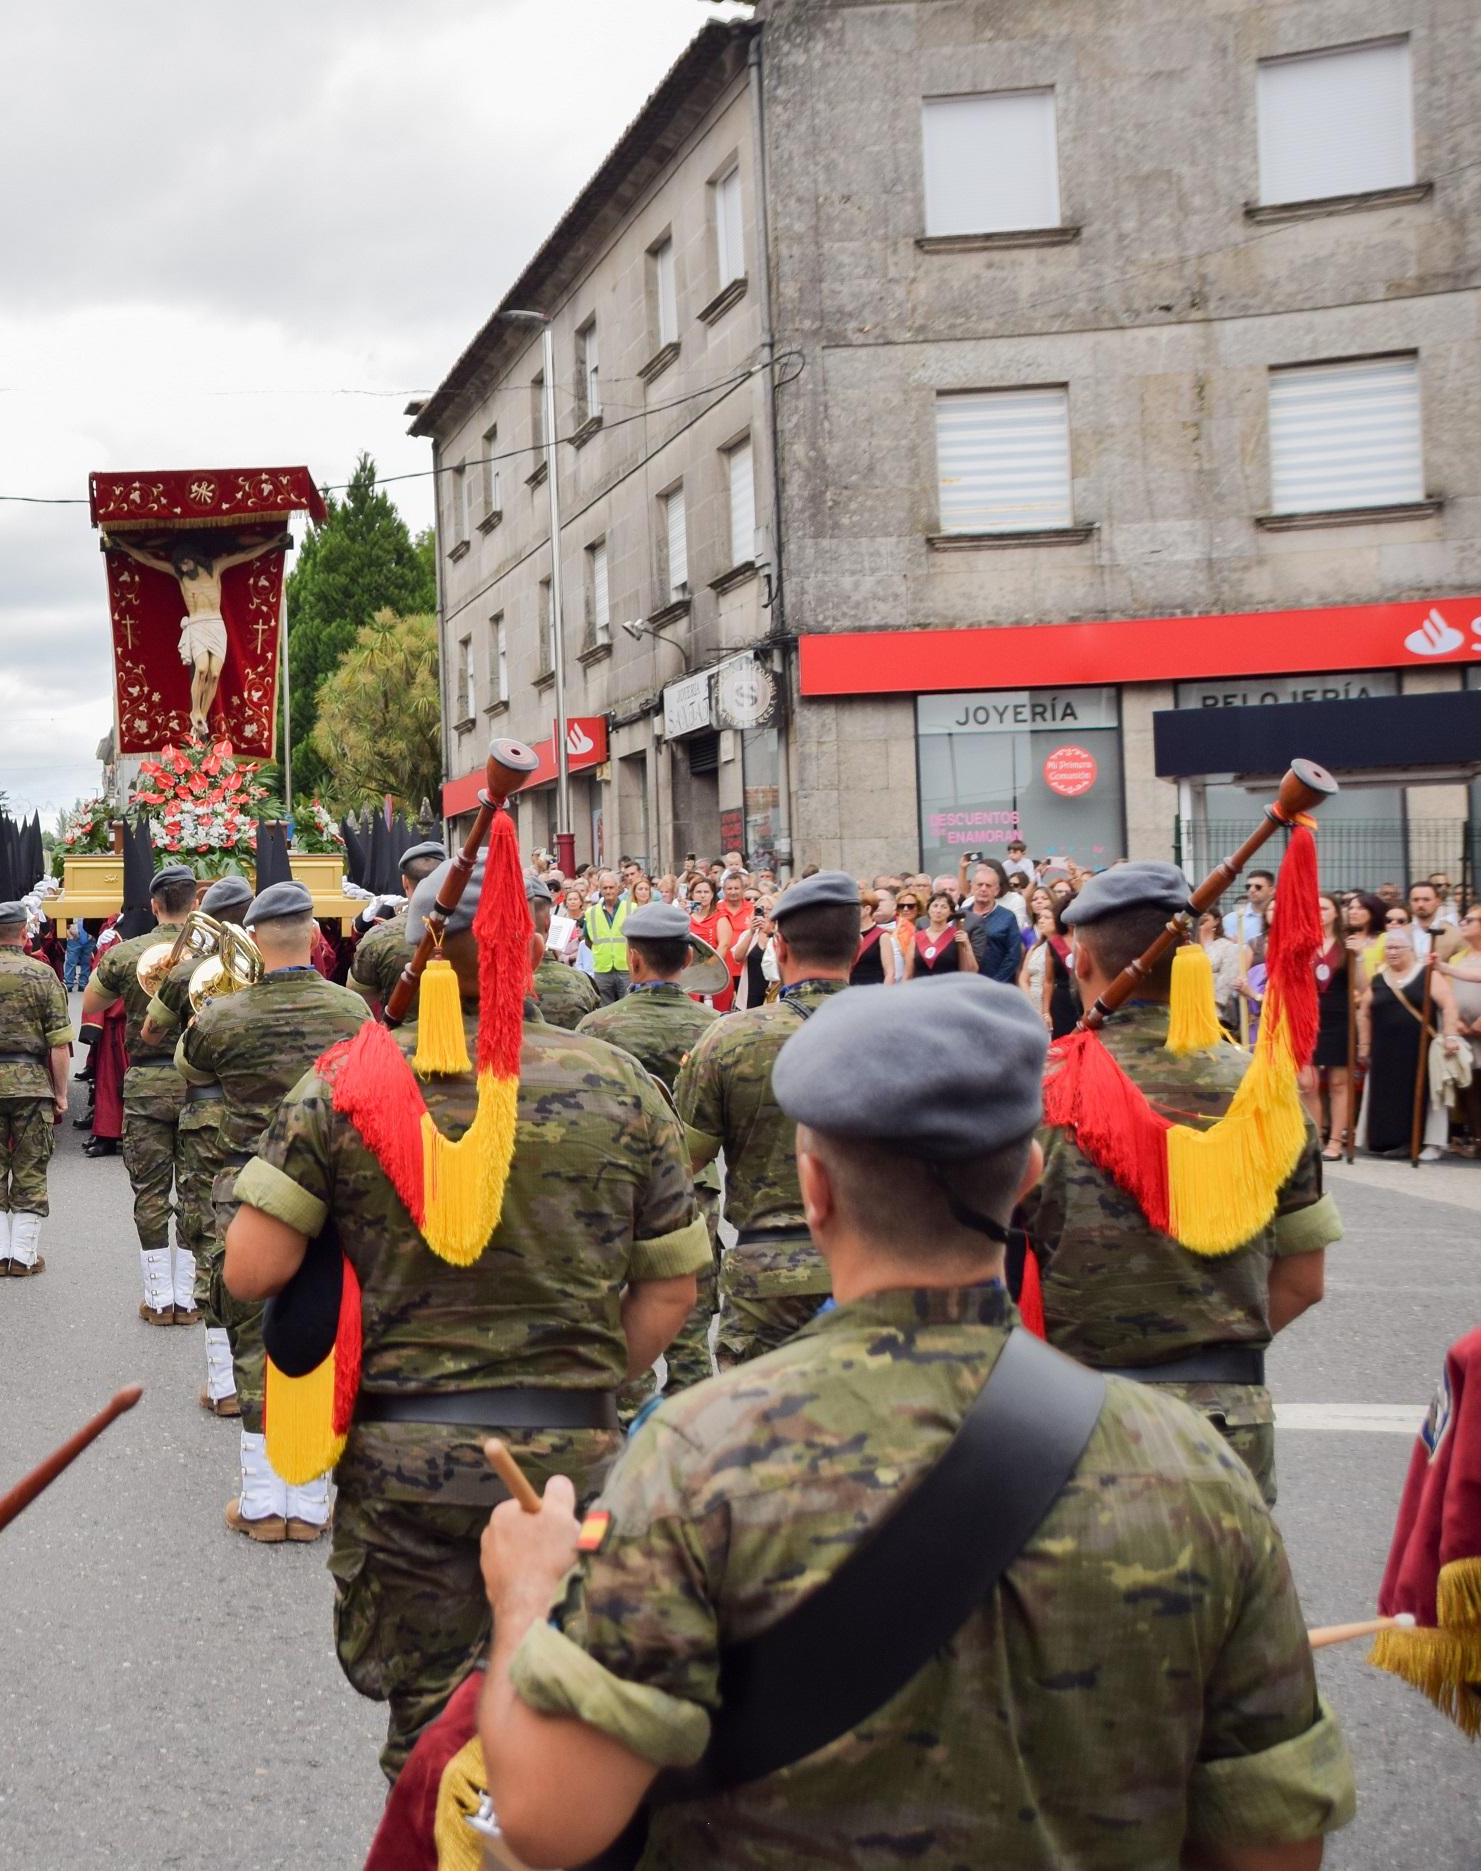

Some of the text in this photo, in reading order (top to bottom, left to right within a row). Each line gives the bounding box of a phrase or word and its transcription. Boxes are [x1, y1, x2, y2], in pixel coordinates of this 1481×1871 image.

[955, 696, 1078, 726] JOYERÍA
[928, 811, 1020, 828] DESCUENTOS
[947, 829, 1023, 844] ENAMORAN
